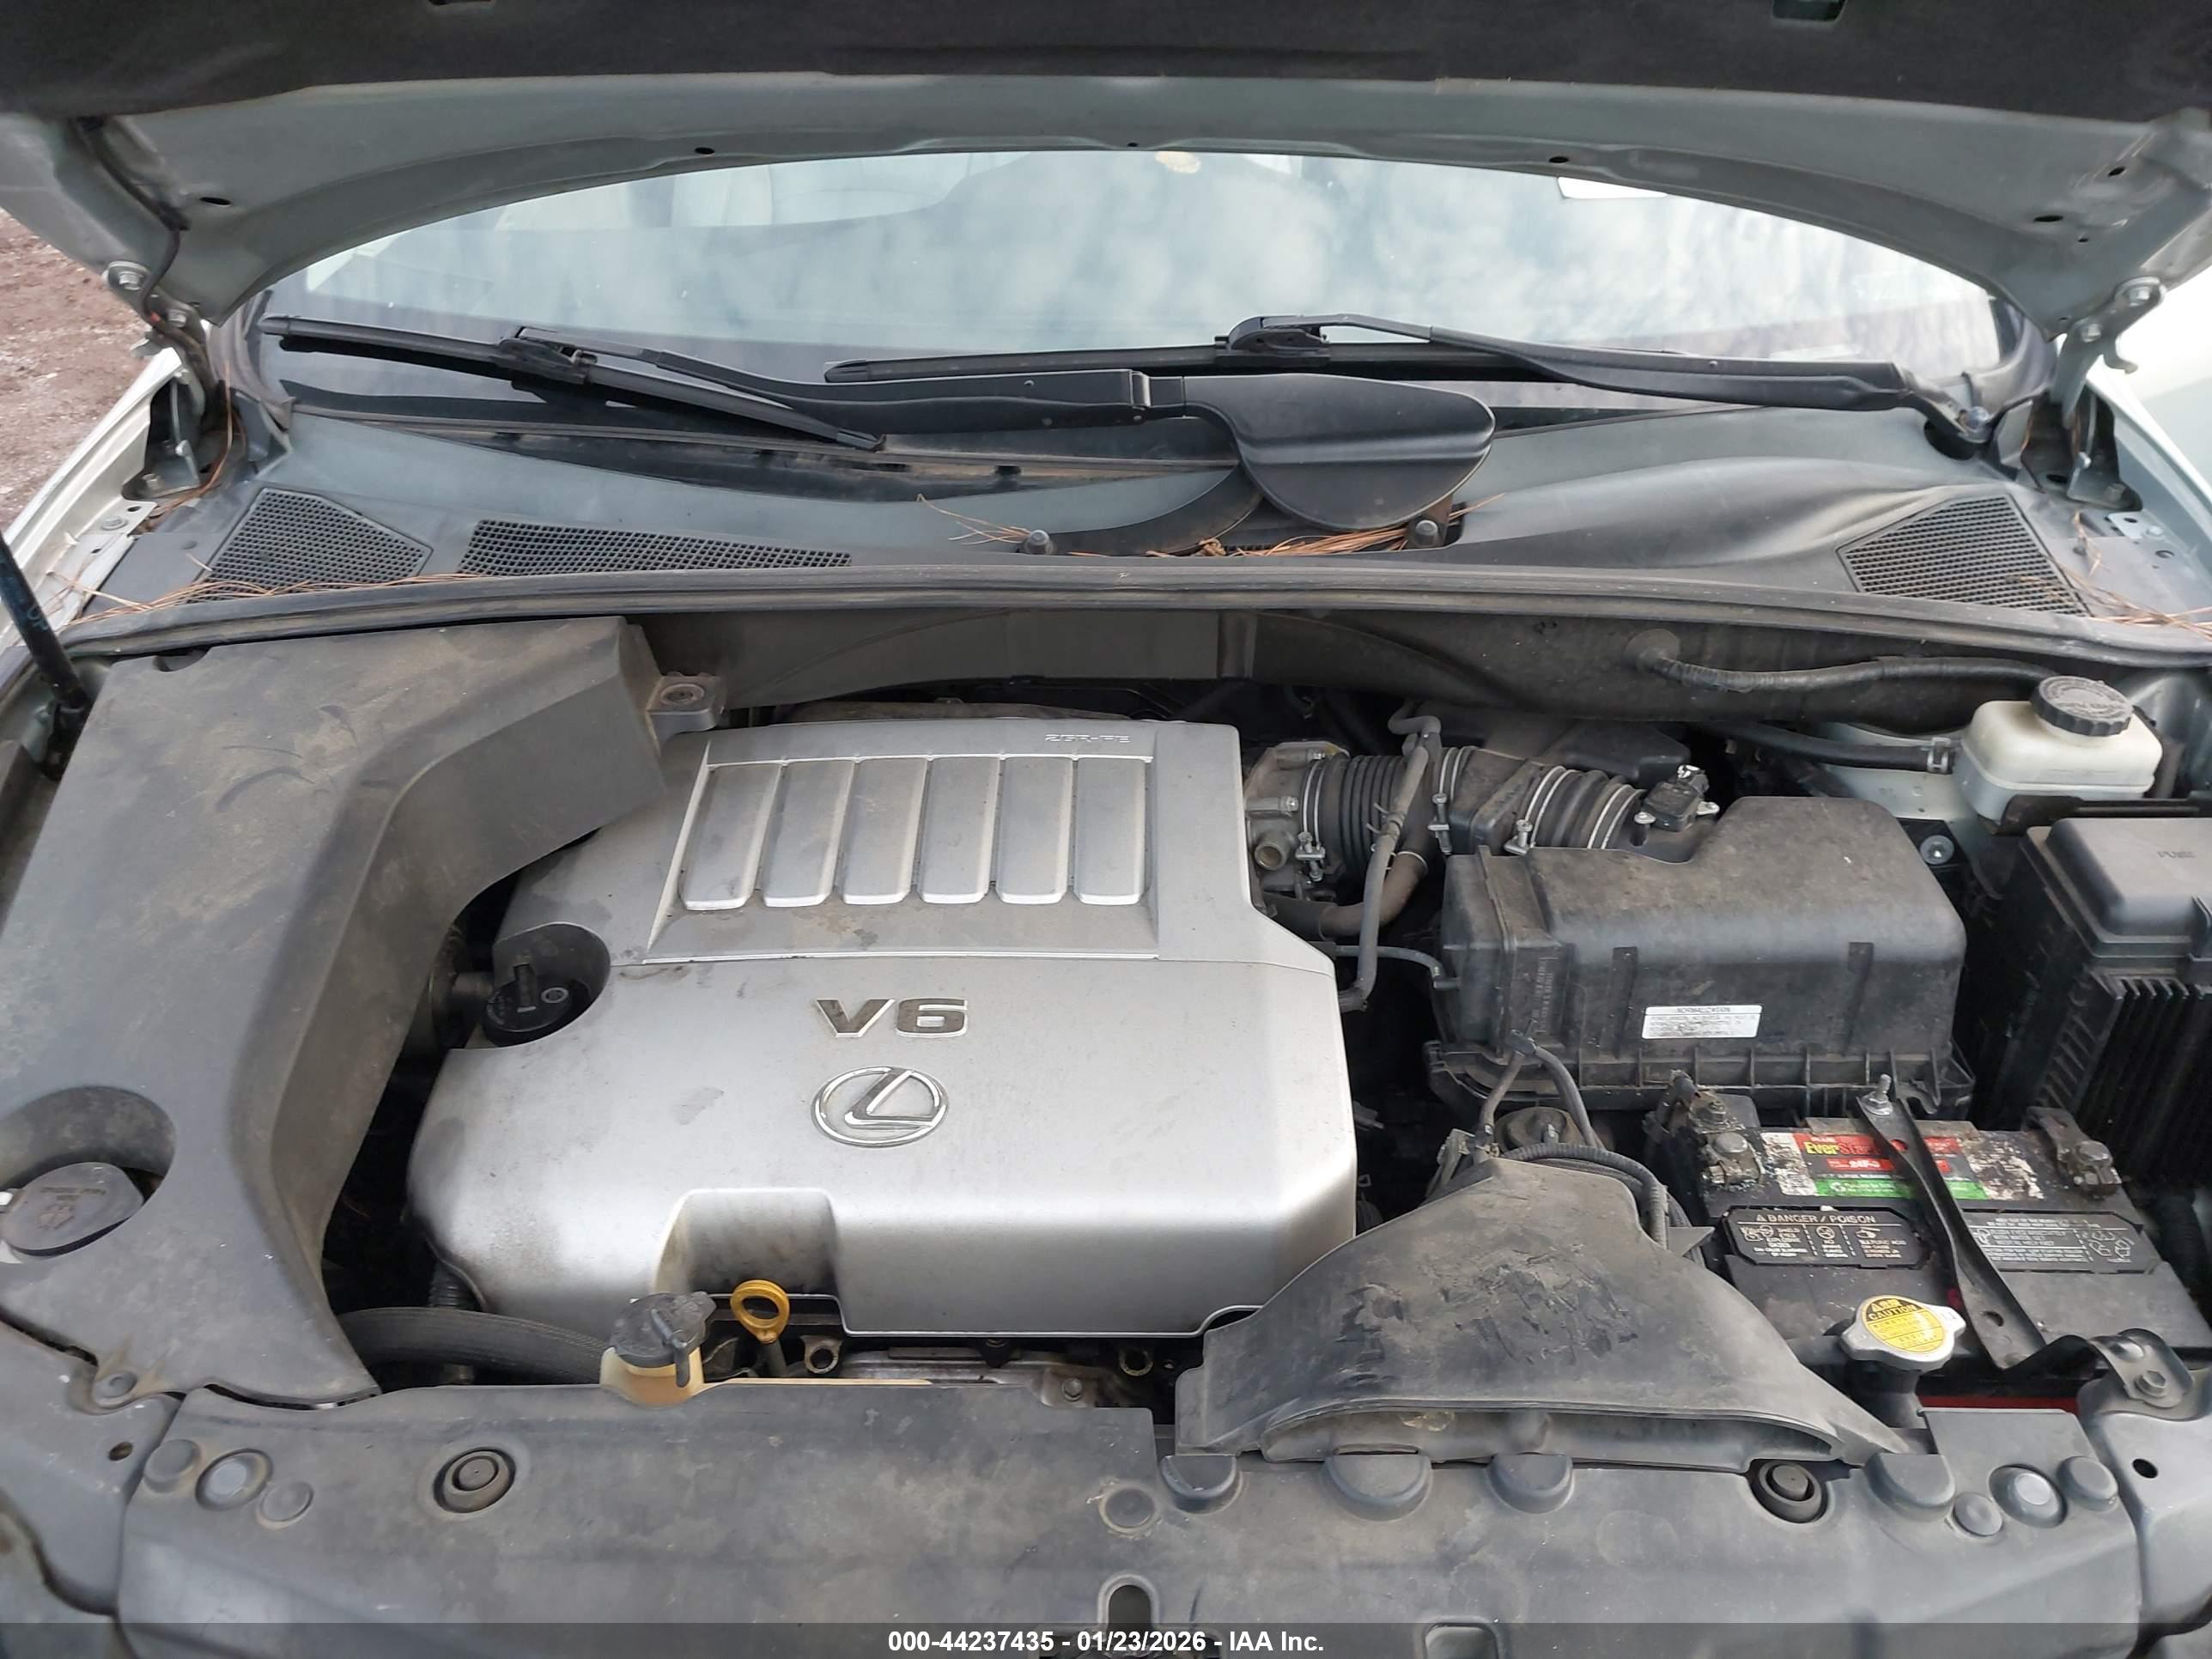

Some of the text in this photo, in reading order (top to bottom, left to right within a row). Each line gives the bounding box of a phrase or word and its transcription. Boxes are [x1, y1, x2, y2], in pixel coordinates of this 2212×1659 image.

[815, 997, 969, 1038] V6
[1767, 1215, 1817, 1224] DANGER
[1829, 1215, 1876, 1224] POISON
[1868, 1304, 1917, 1321] CAUTION
